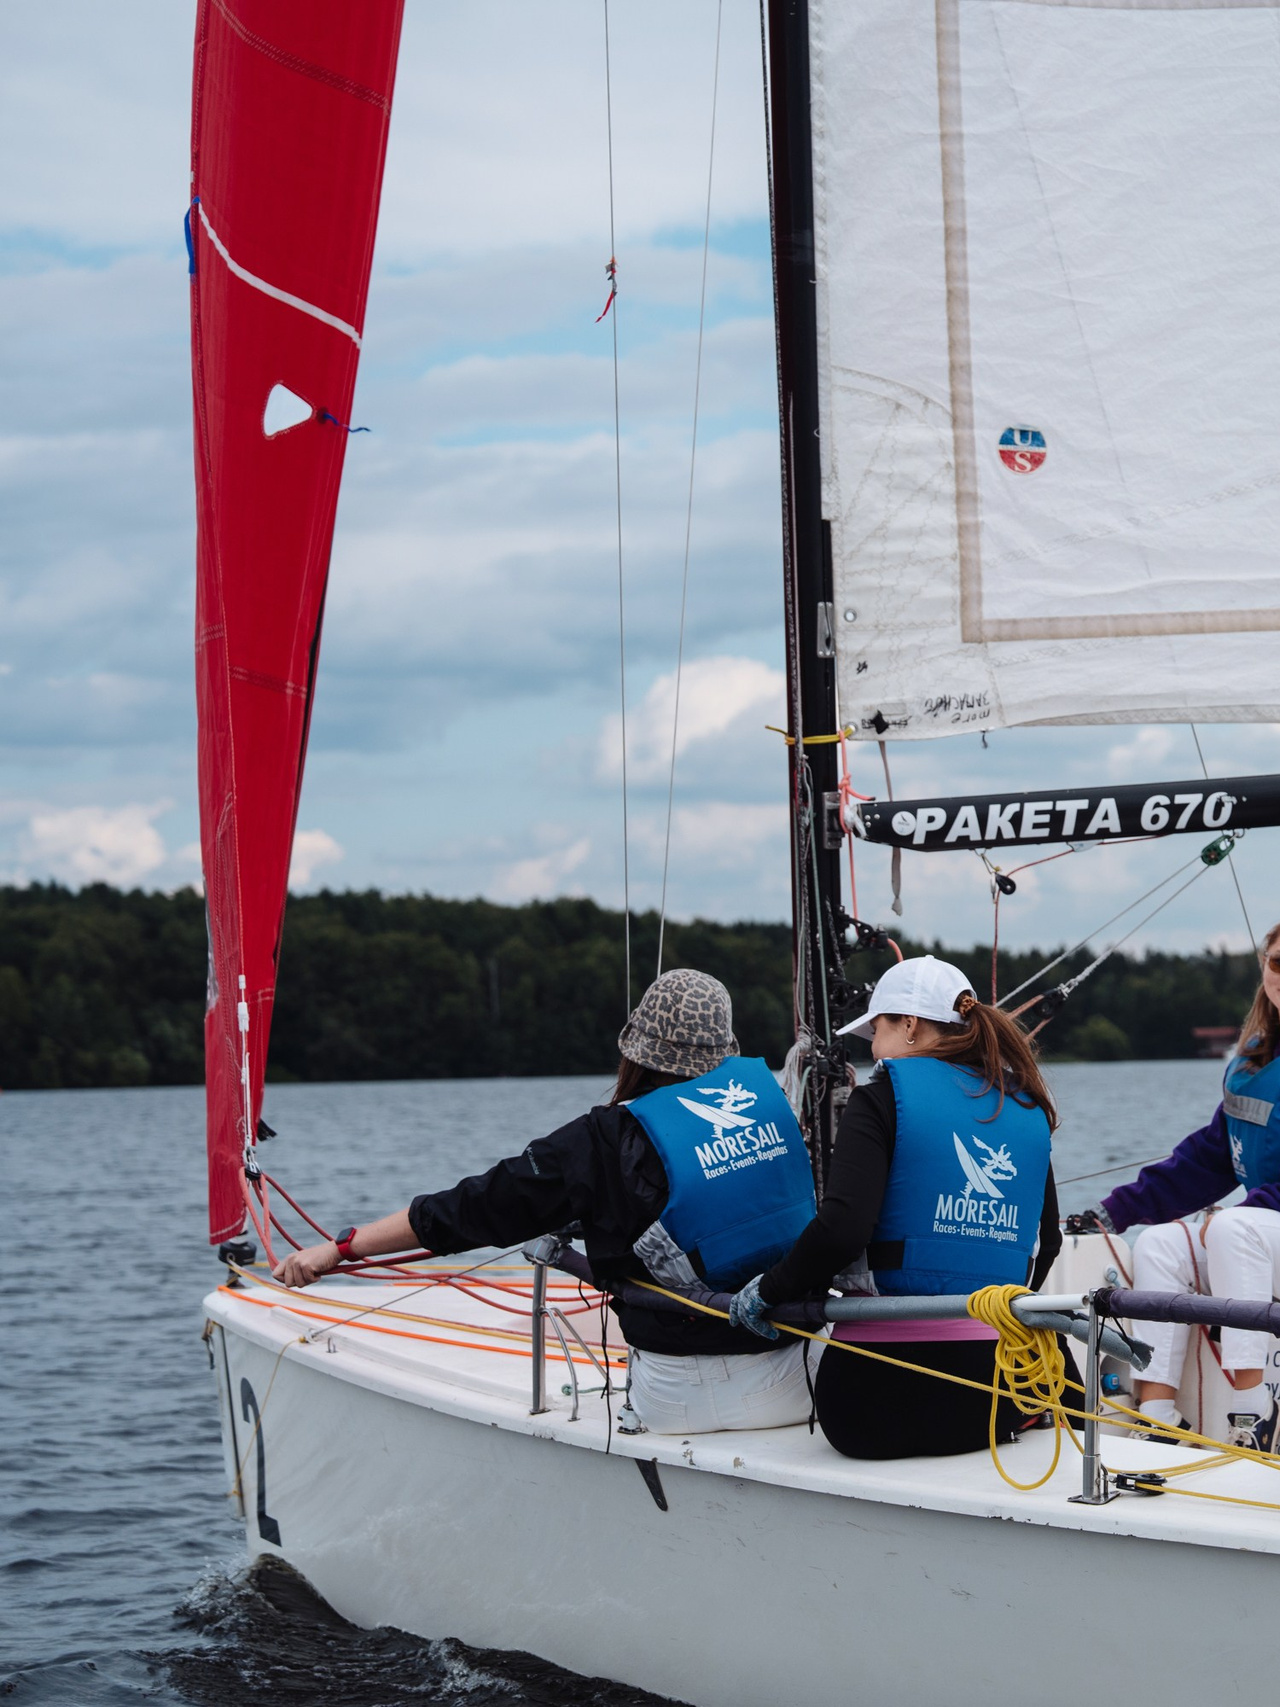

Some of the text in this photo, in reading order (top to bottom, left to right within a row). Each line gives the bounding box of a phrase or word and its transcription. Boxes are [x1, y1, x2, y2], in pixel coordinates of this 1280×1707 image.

[1140, 791, 1236, 832] 670
[694, 1121, 785, 1169] MORESAIL
[934, 1193, 1019, 1229] MORESAIL
